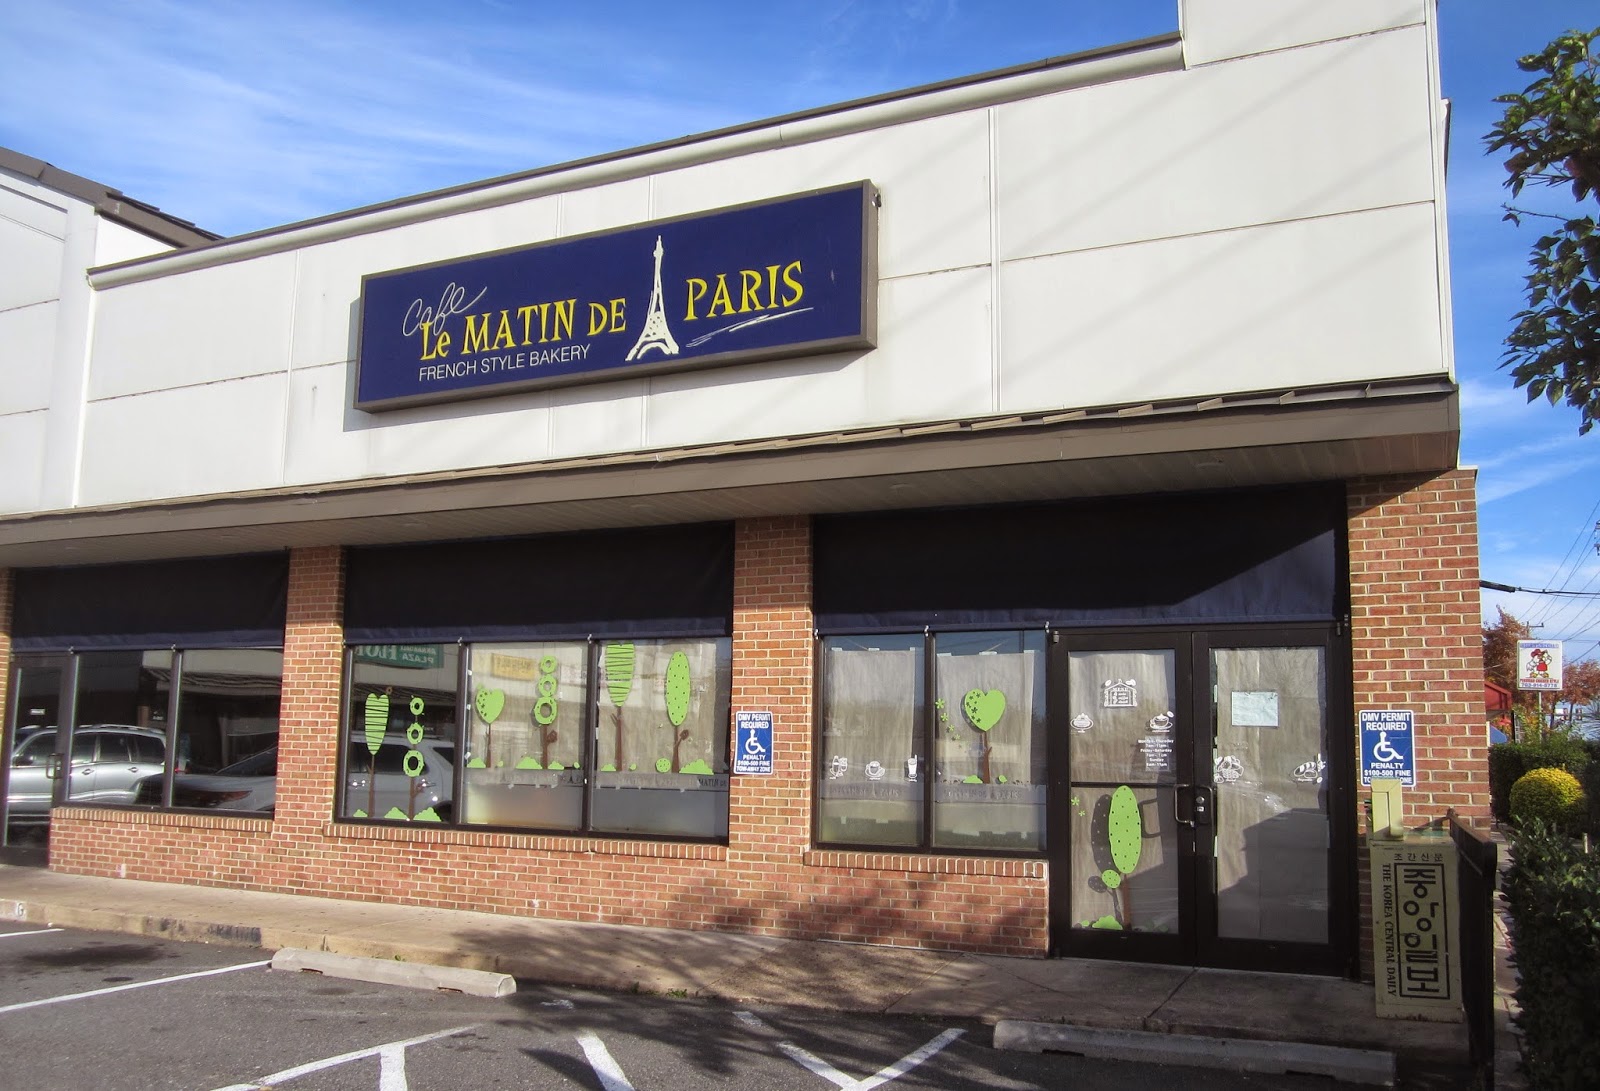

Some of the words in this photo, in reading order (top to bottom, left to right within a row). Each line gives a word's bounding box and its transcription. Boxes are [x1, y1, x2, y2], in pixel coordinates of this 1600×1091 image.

[420, 322, 451, 360] Le
[461, 298, 577, 355] MATIN
[587, 298, 627, 336] DE
[683, 260, 804, 321] PARIS
[419, 360, 477, 382] FRENCH
[480, 353, 526, 374] STYLE
[529, 343, 591, 367] BAKERY
[738, 713, 751, 721] DMV
[752, 713, 771, 721] PERMIT
[740, 721, 769, 729] REQUIRED
[1362, 712, 1379, 721] DMV
[1381, 712, 1410, 721] PERMIT
[1366, 722, 1407, 731] REQUIRED
[1382, 863, 1392, 882] THE
[1383, 885, 1394, 918] KOREA
[1384, 921, 1396, 965] CENTRAL
[1403, 868, 1441, 993] 중앙일보
[1386, 967, 1398, 998] DAILY
